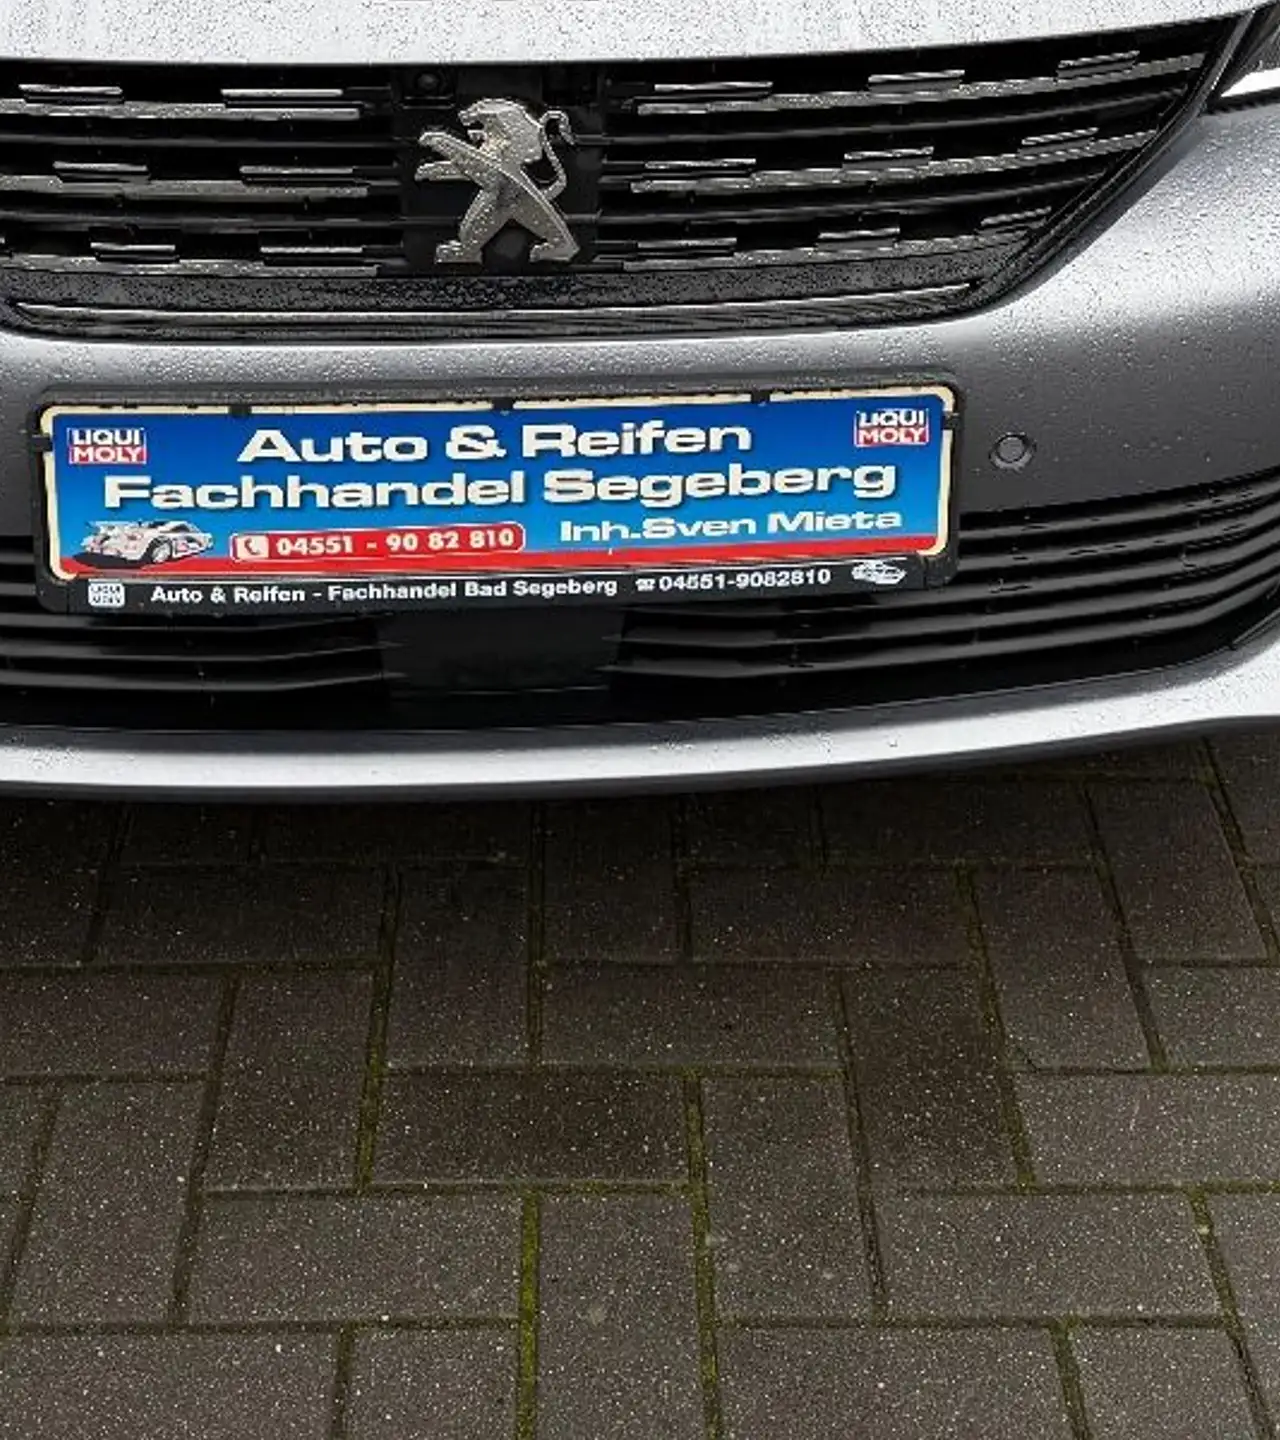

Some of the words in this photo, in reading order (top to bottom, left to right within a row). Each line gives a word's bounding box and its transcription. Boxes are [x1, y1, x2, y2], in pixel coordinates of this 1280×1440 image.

[858, 409, 925, 427] LIQUI
[71, 428, 141, 446] LIQUI
[236, 428, 428, 462] Auto
[445, 424, 507, 461] &
[521, 420, 752, 458] Reifen
[857, 427, 926, 445] MOLY
[72, 446, 146, 464] MOLY
[104, 471, 525, 508] Fachhandel
[542, 463, 897, 508] Segeberg
[276, 535, 353, 555] 04551
[385, 533, 418, 552] 90
[427, 531, 460, 550] 82
[470, 528, 514, 548] 810
[150, 586, 203, 603] Auto
[209, 586, 226, 603] &
[234, 584, 306, 603] Reifen
[328, 582, 457, 602] Fachhandel
[464, 580, 507, 598] Bad
[512, 577, 618, 599] Segeberg
